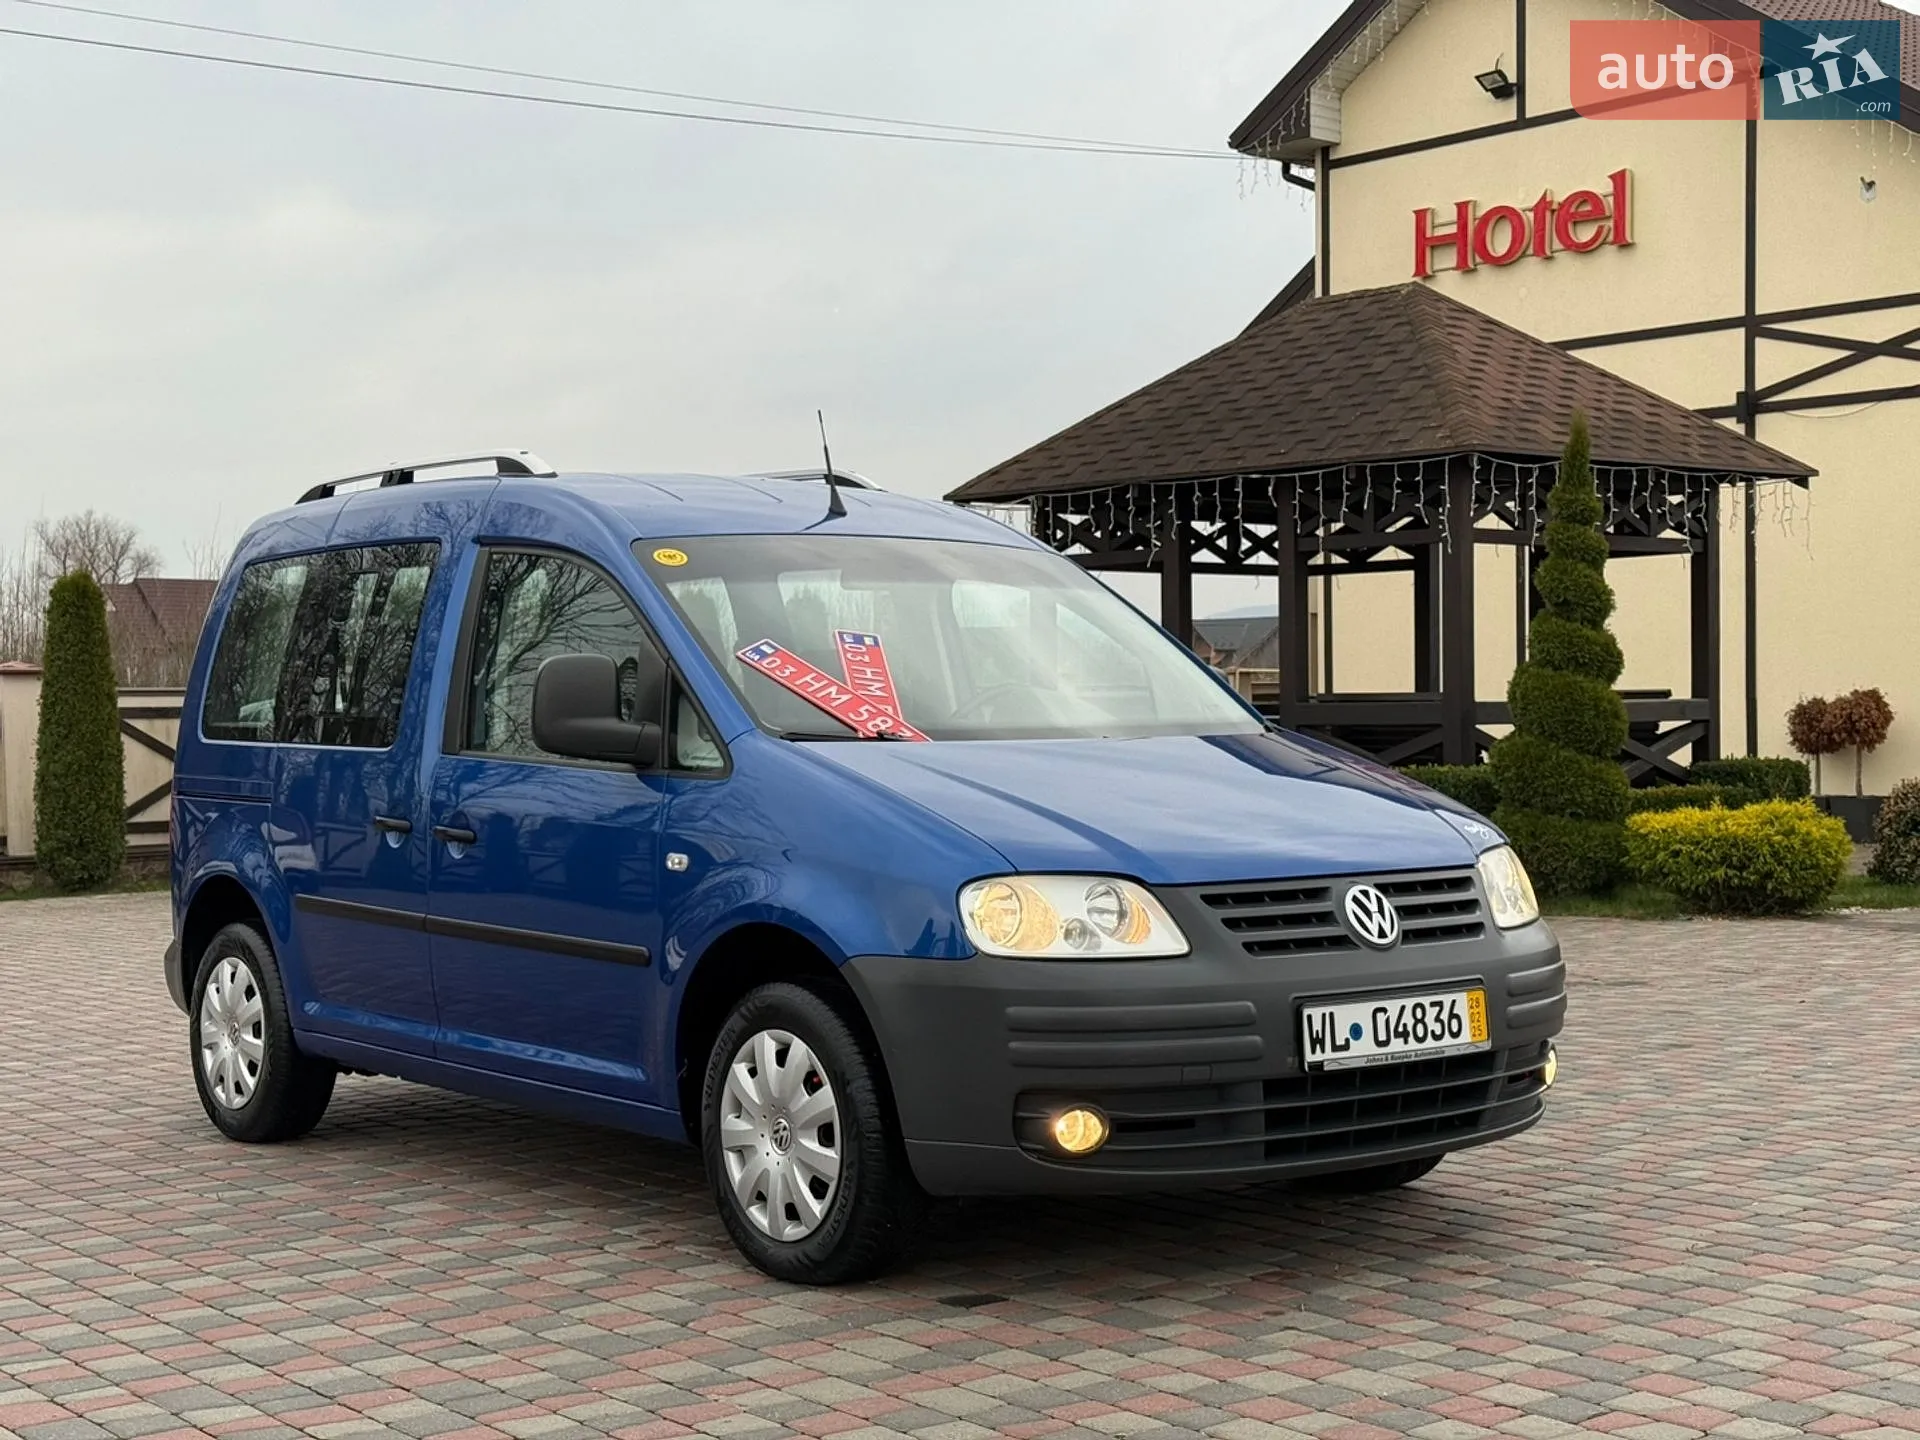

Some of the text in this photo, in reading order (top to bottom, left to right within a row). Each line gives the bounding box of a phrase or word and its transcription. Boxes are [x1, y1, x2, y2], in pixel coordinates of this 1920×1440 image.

[1412, 168, 1635, 279] Hotel
[843, 643, 872, 663] 03
[761, 656, 798, 677] 03
[794, 673, 853, 707] HM
[1306, 999, 1462, 1055] WL 04836
